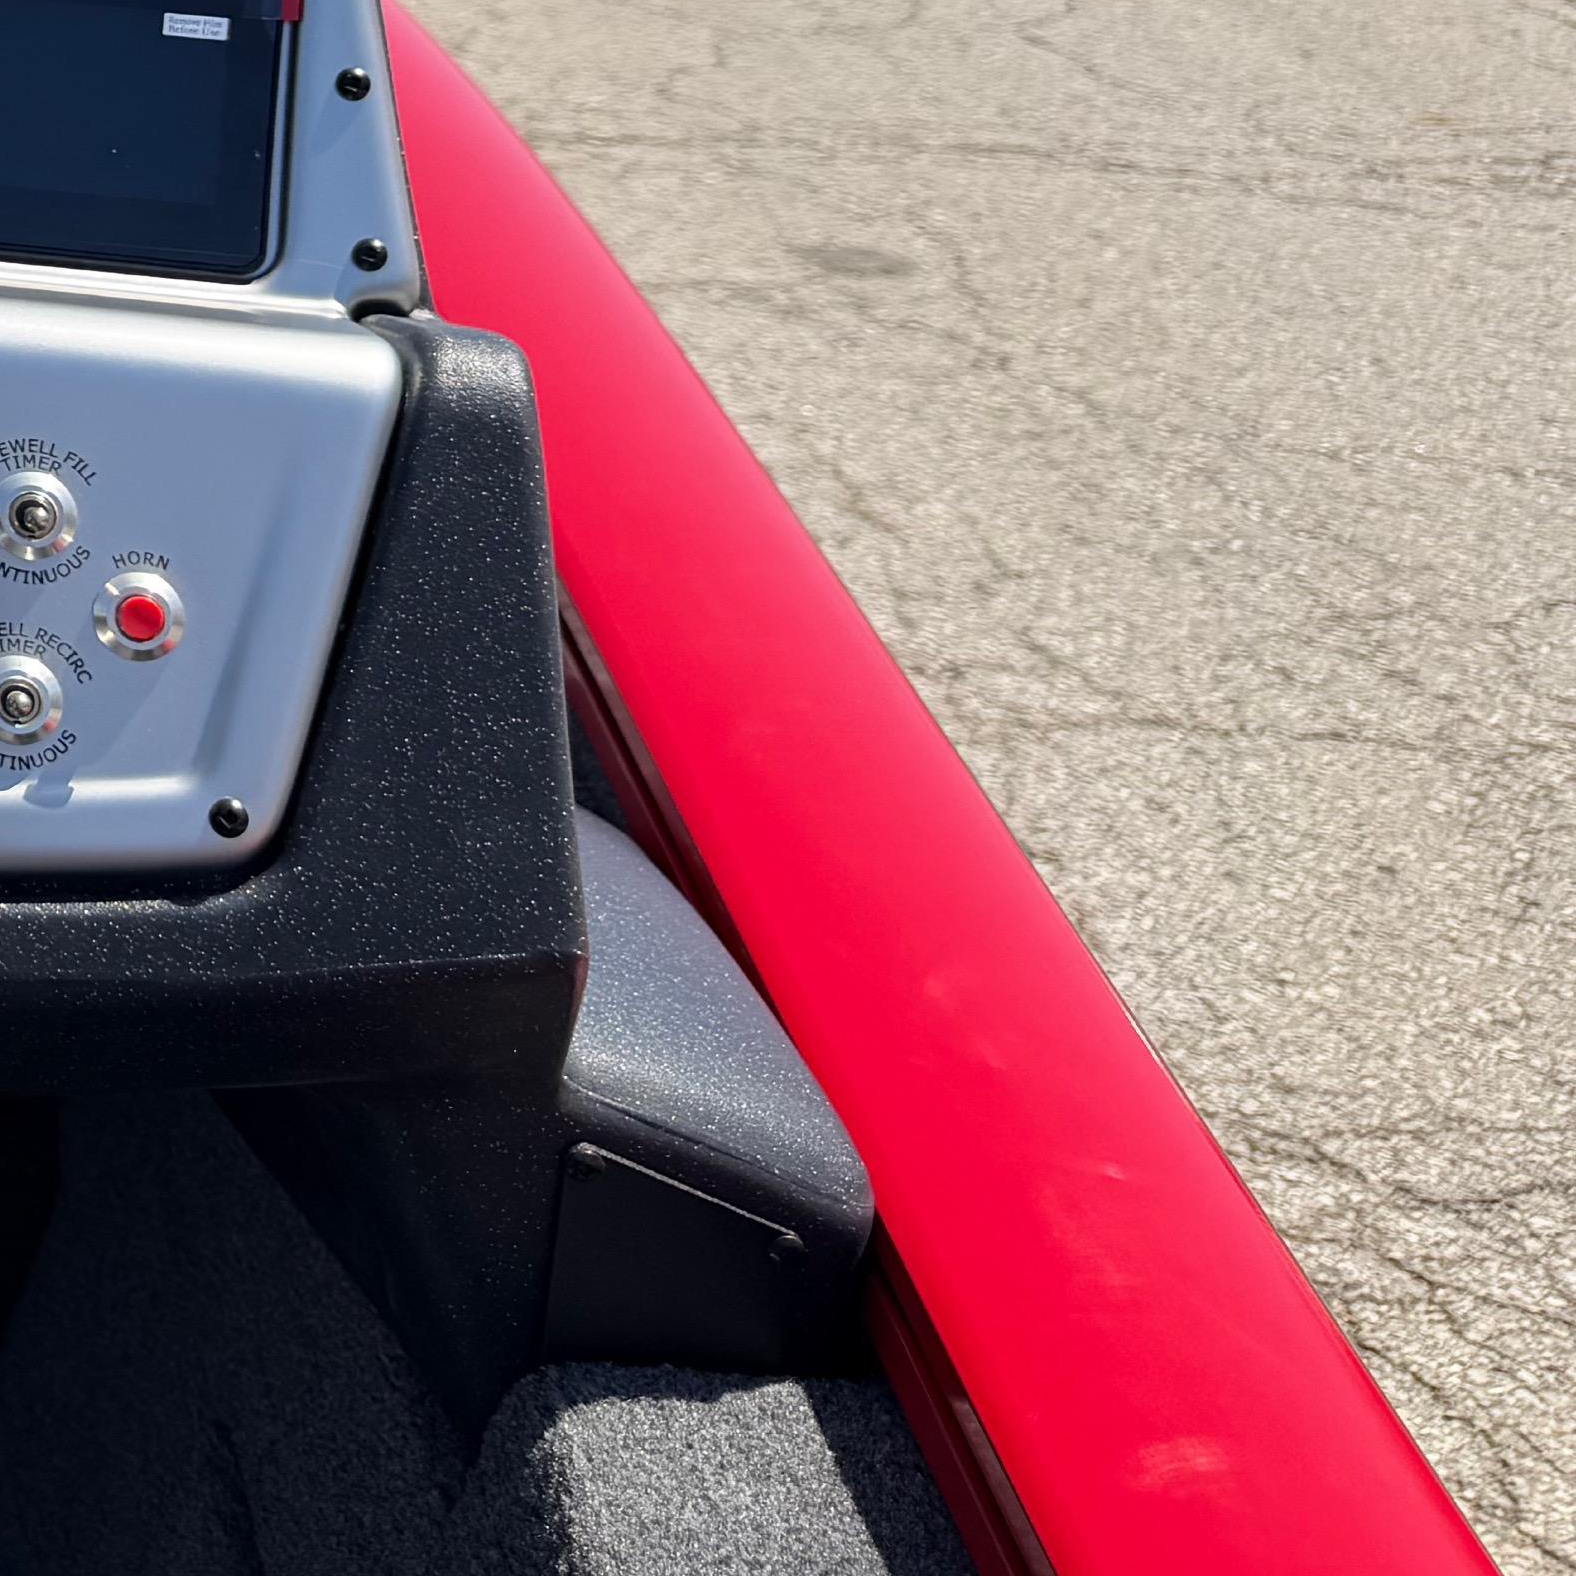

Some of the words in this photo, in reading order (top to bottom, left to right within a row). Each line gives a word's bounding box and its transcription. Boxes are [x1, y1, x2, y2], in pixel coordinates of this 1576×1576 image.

[0, 454, 62, 477] TIMER
[63, 451, 97, 487] FILL
[112, 550, 170, 571] HORN
[35, 627, 93, 684] RECIRC
